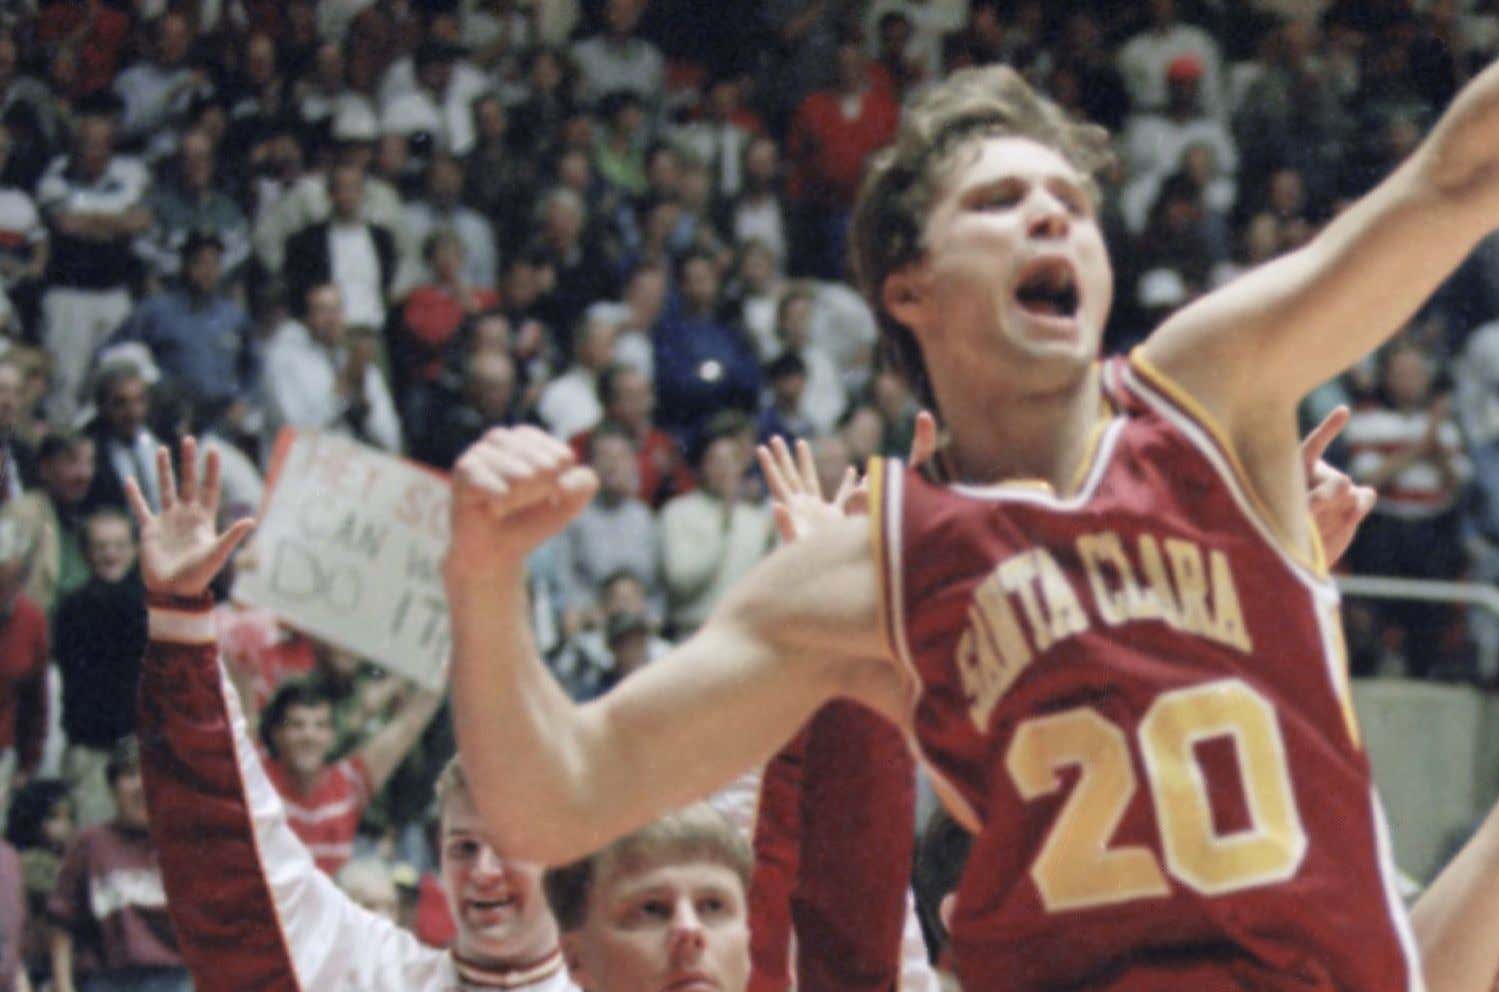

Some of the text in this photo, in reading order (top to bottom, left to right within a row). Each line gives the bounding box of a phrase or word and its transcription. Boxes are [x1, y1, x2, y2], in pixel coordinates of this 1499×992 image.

[270, 537, 362, 612] DO
[297, 494, 388, 559] CAN
[1076, 531, 1253, 653] CLARA
[1005, 678, 1308, 914] 20
